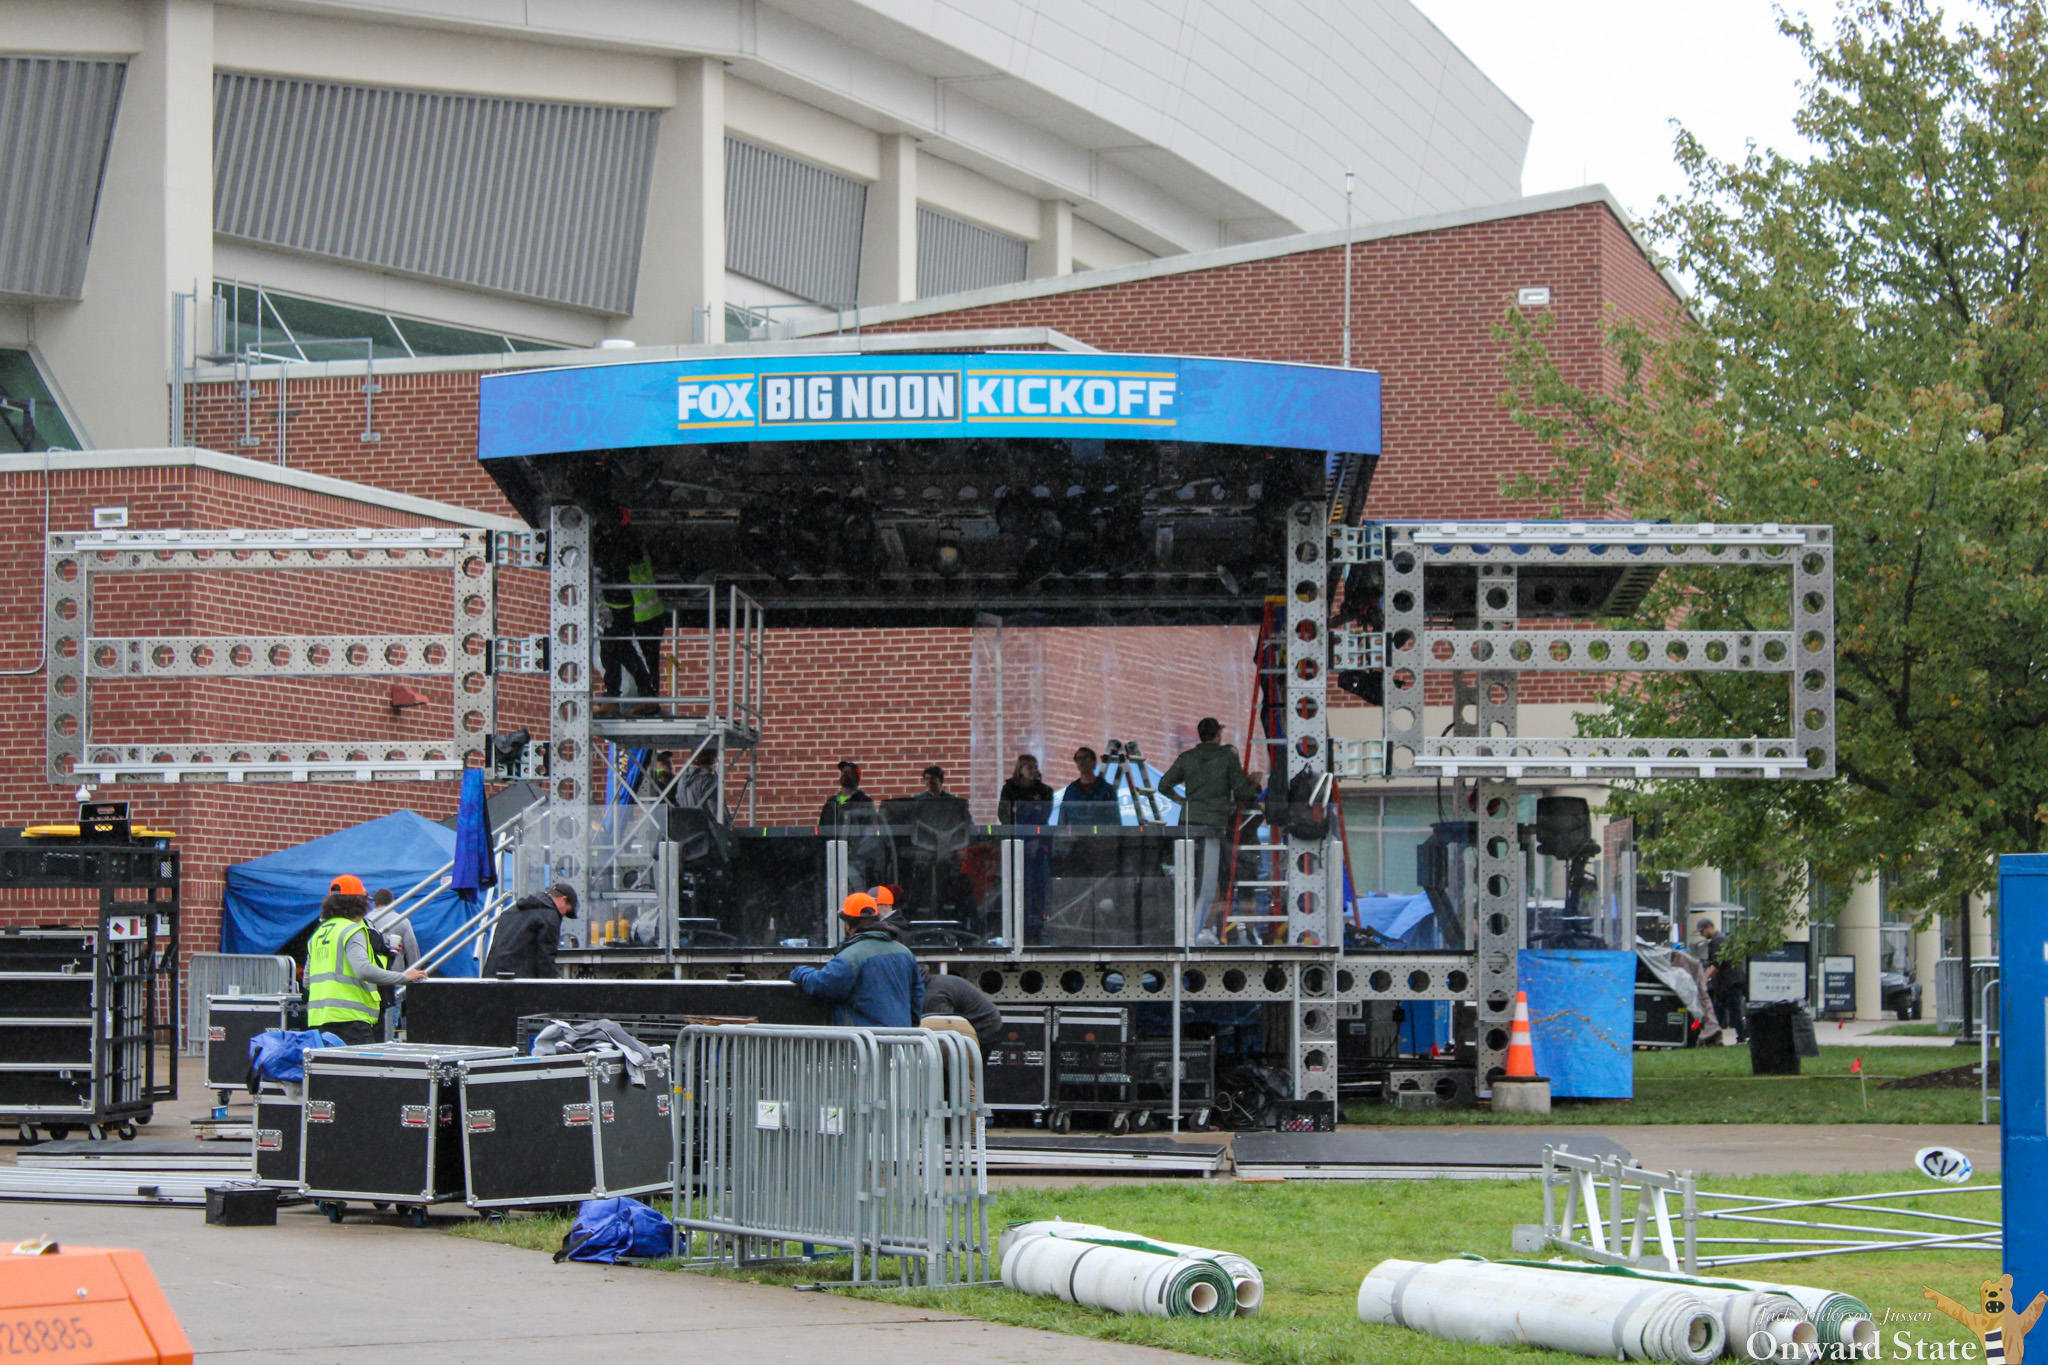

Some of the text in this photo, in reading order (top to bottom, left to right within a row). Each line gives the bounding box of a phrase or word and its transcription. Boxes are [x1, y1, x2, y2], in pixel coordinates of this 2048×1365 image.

[677, 375, 1177, 421] FOX BIG NOON KICKOFF
[0, 1316, 94, 1355] 28885
